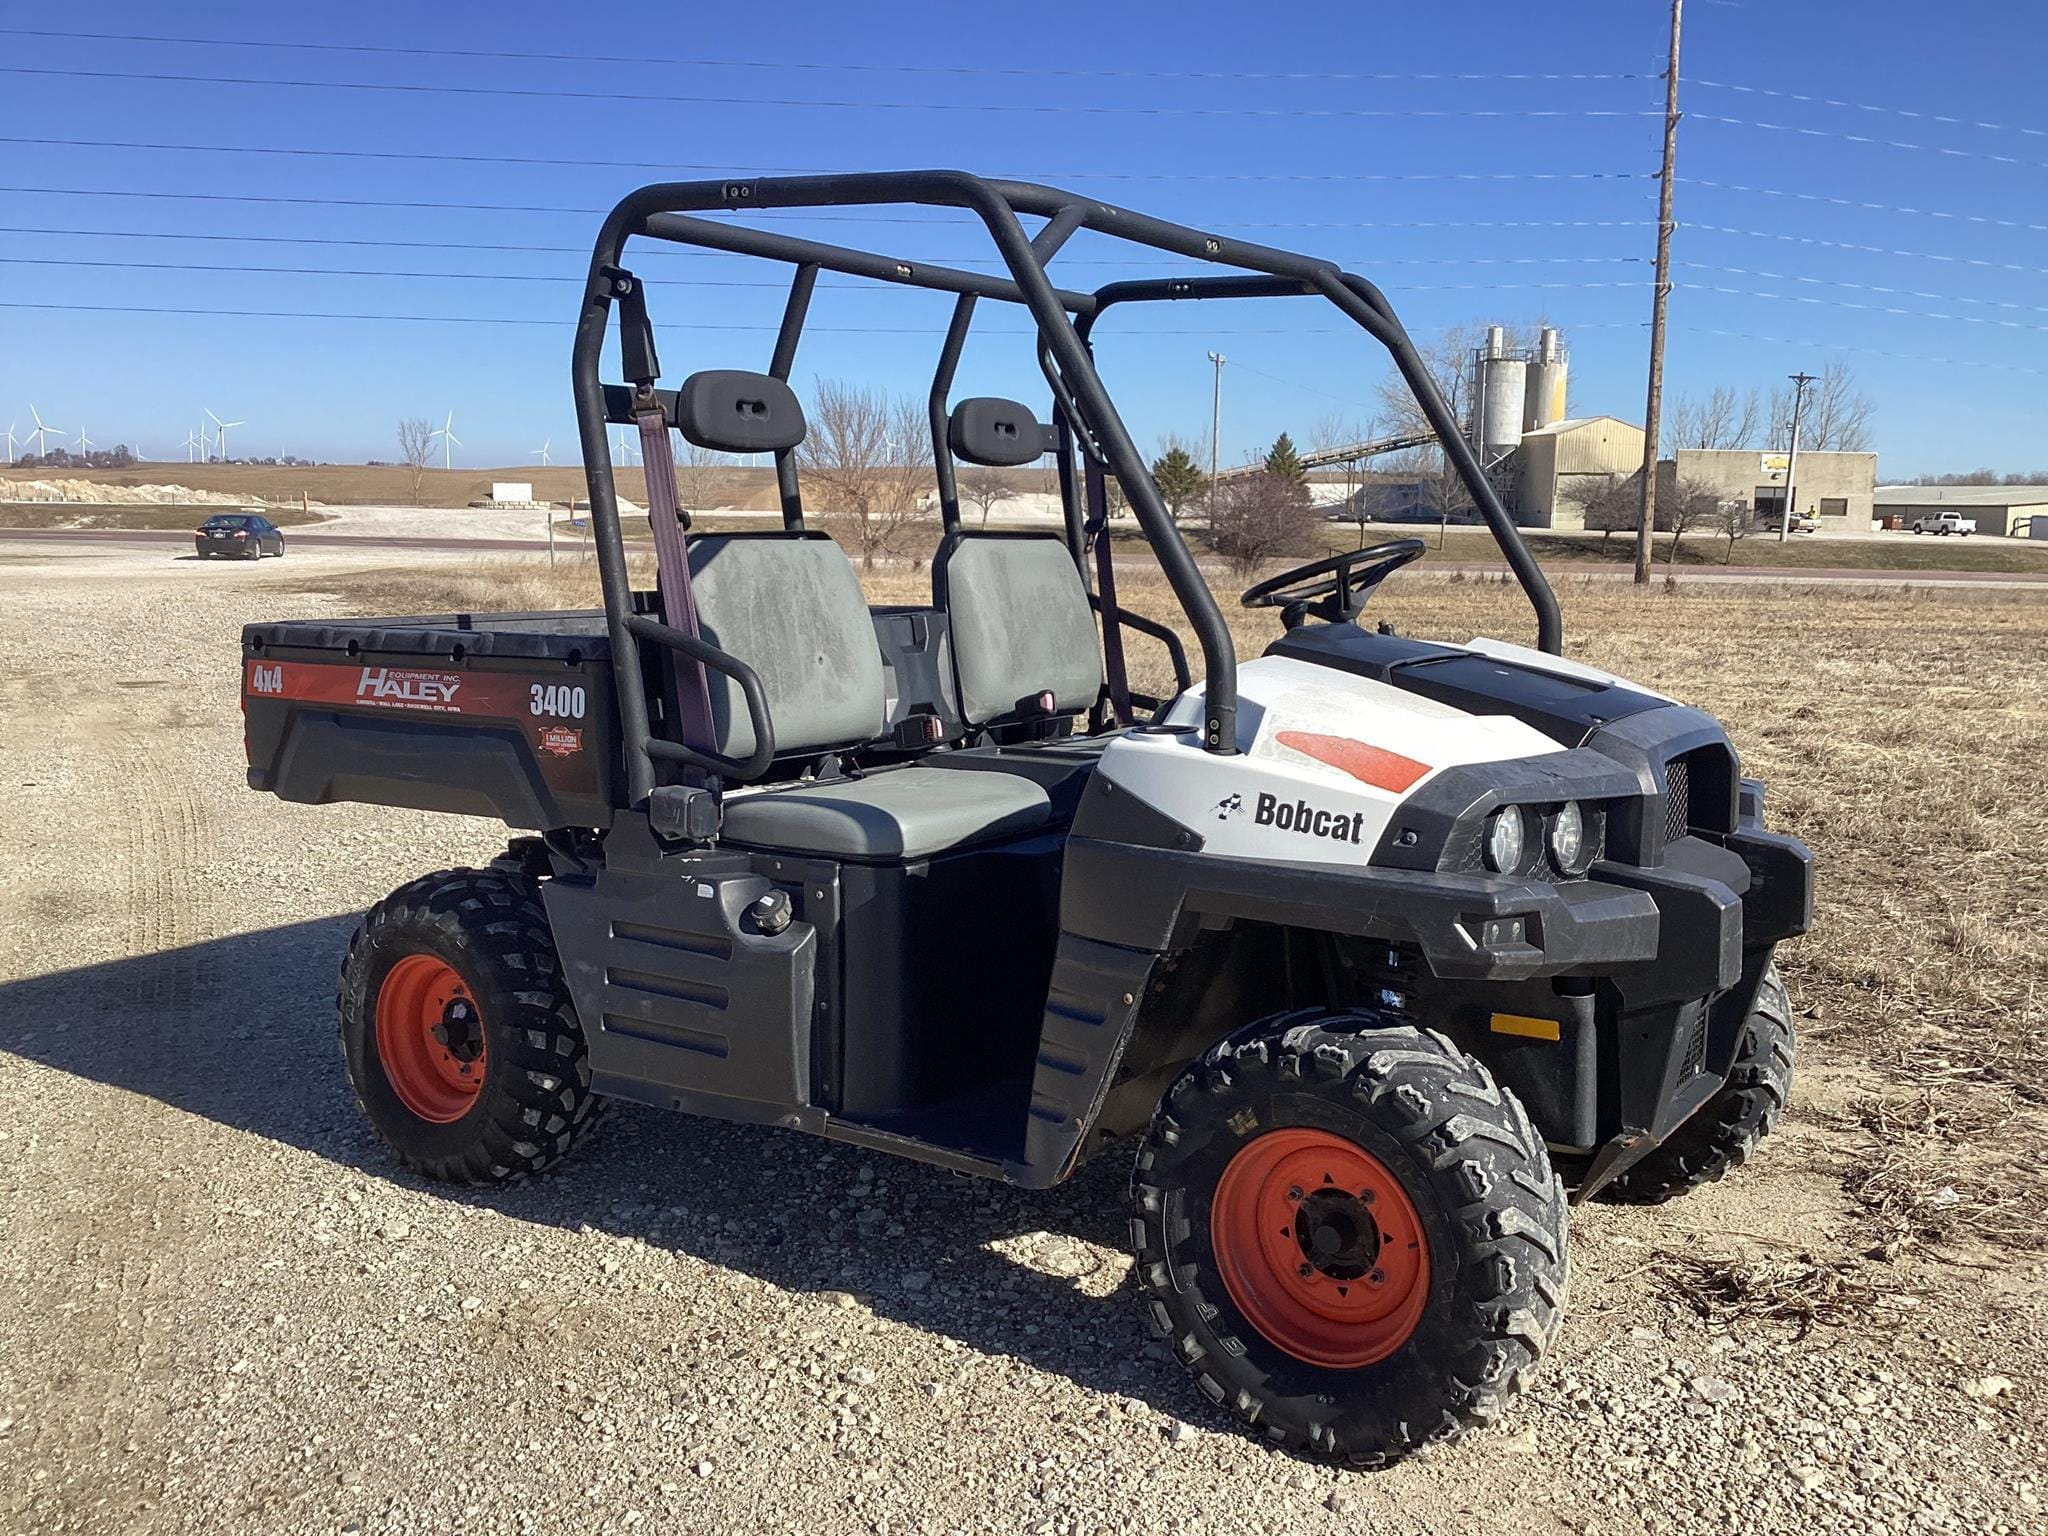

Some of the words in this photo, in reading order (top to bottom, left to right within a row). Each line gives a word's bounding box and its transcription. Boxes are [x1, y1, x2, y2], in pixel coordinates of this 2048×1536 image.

[253, 665, 283, 693] 4x4
[357, 667, 461, 702] HALEY
[389, 671, 440, 681] EQUIPMENT
[530, 684, 586, 719] 3400
[549, 734, 577, 744] MILLION
[1254, 792, 1364, 845] Bobcat
